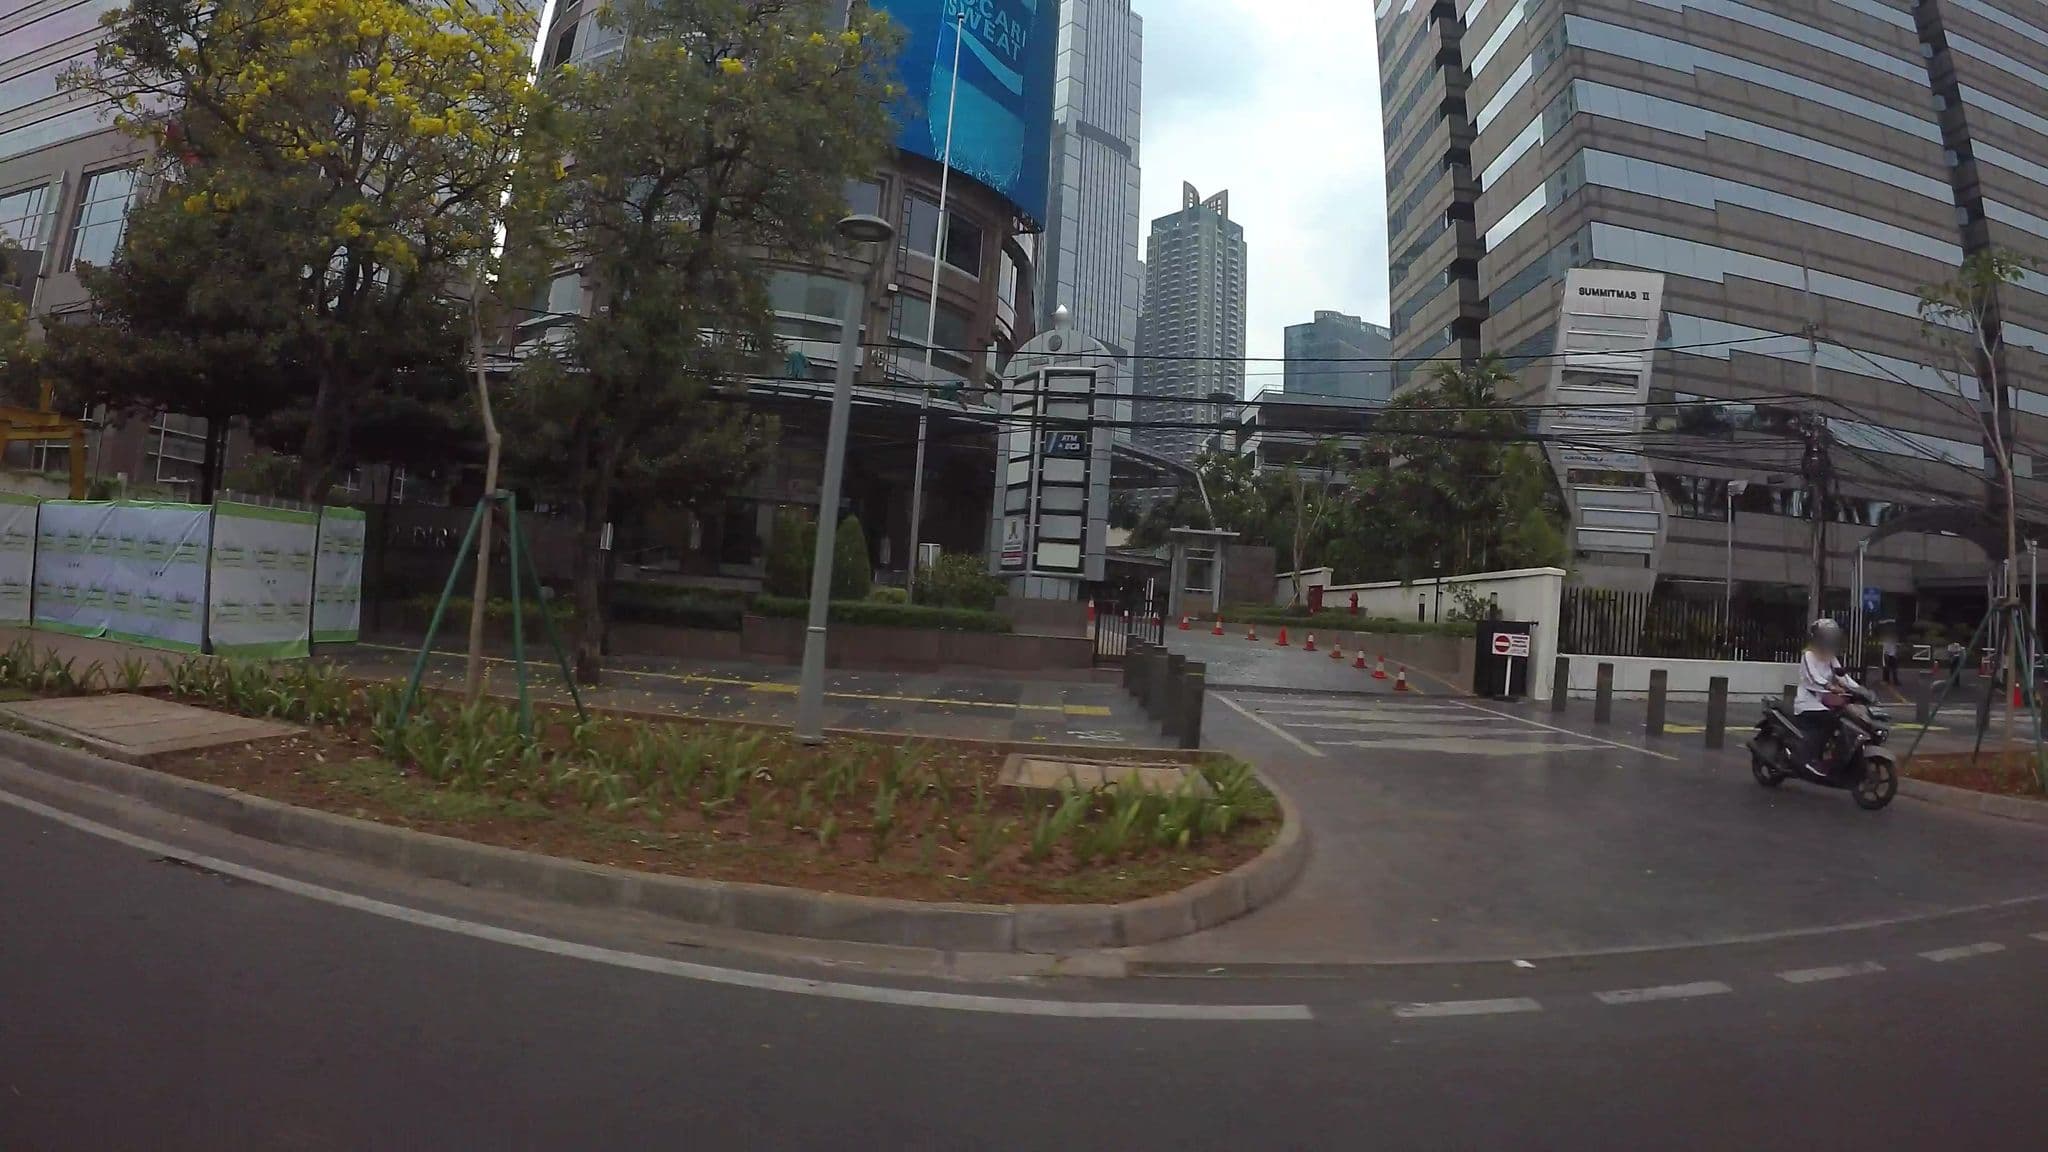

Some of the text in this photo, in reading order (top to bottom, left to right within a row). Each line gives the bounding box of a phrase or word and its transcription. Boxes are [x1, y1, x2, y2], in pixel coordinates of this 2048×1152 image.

[948, 0, 1021, 61] SWEAT
[965, 0, 1026, 47] CARI
[1578, 286, 1637, 299] SUMMITMAS
[1061, 434, 1078, 442] ATM
